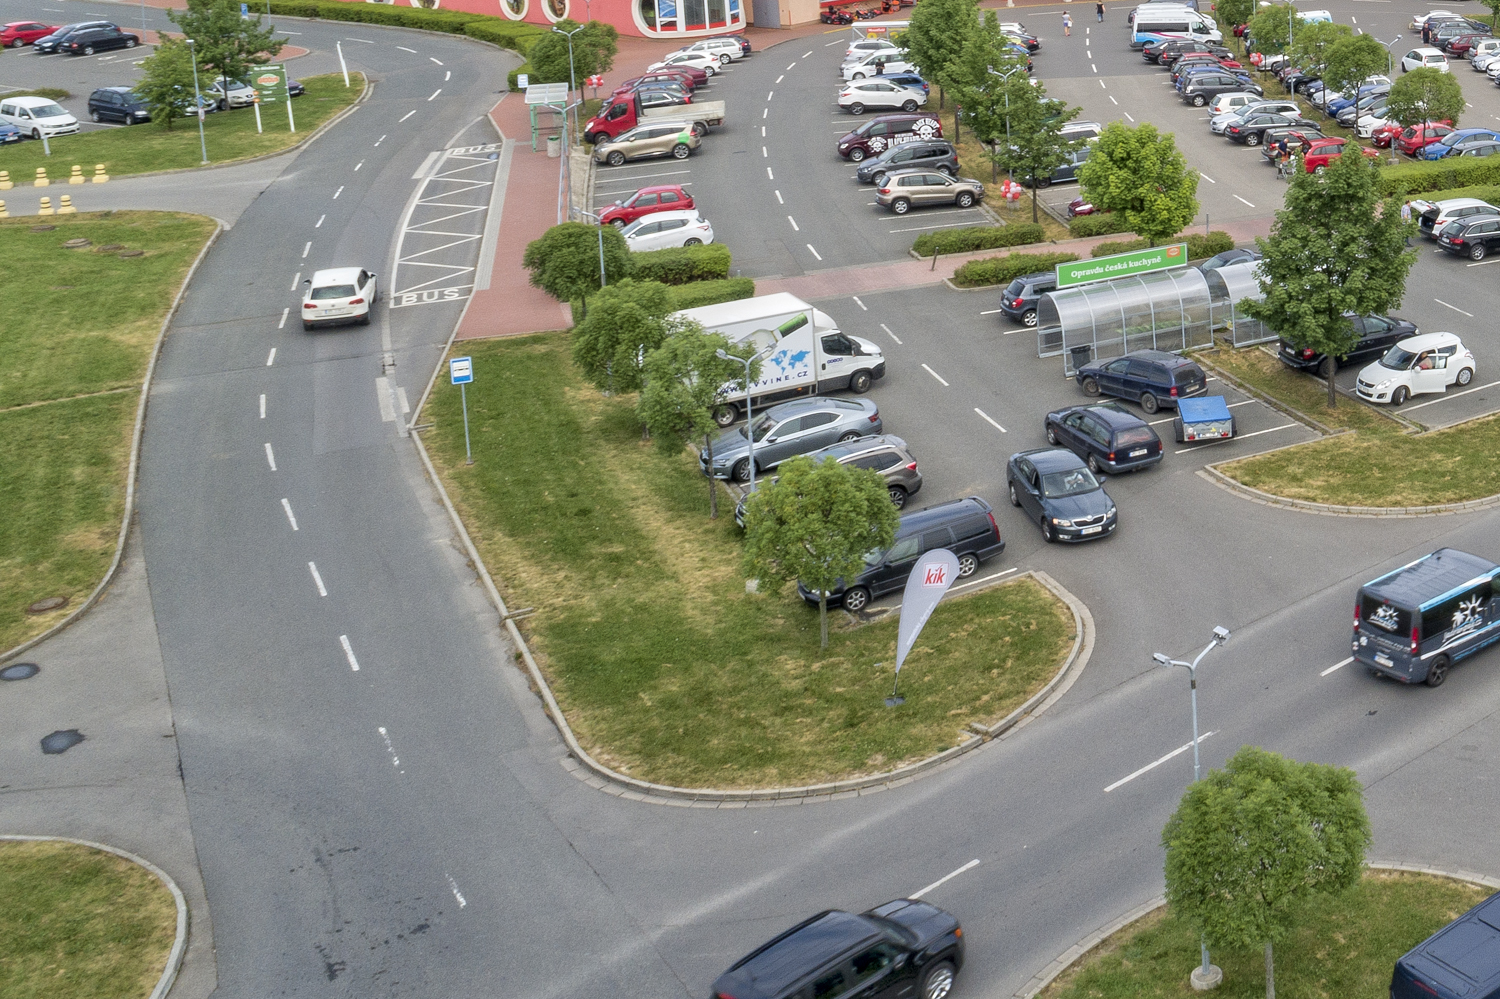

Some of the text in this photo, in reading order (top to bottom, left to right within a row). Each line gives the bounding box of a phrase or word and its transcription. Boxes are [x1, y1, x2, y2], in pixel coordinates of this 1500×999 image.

[452, 145, 496, 155] BUS
[1071, 256, 1161, 278] Opravdu česká kuchyně
[402, 288, 460, 305] BUS
[925, 565, 945, 584] kik
